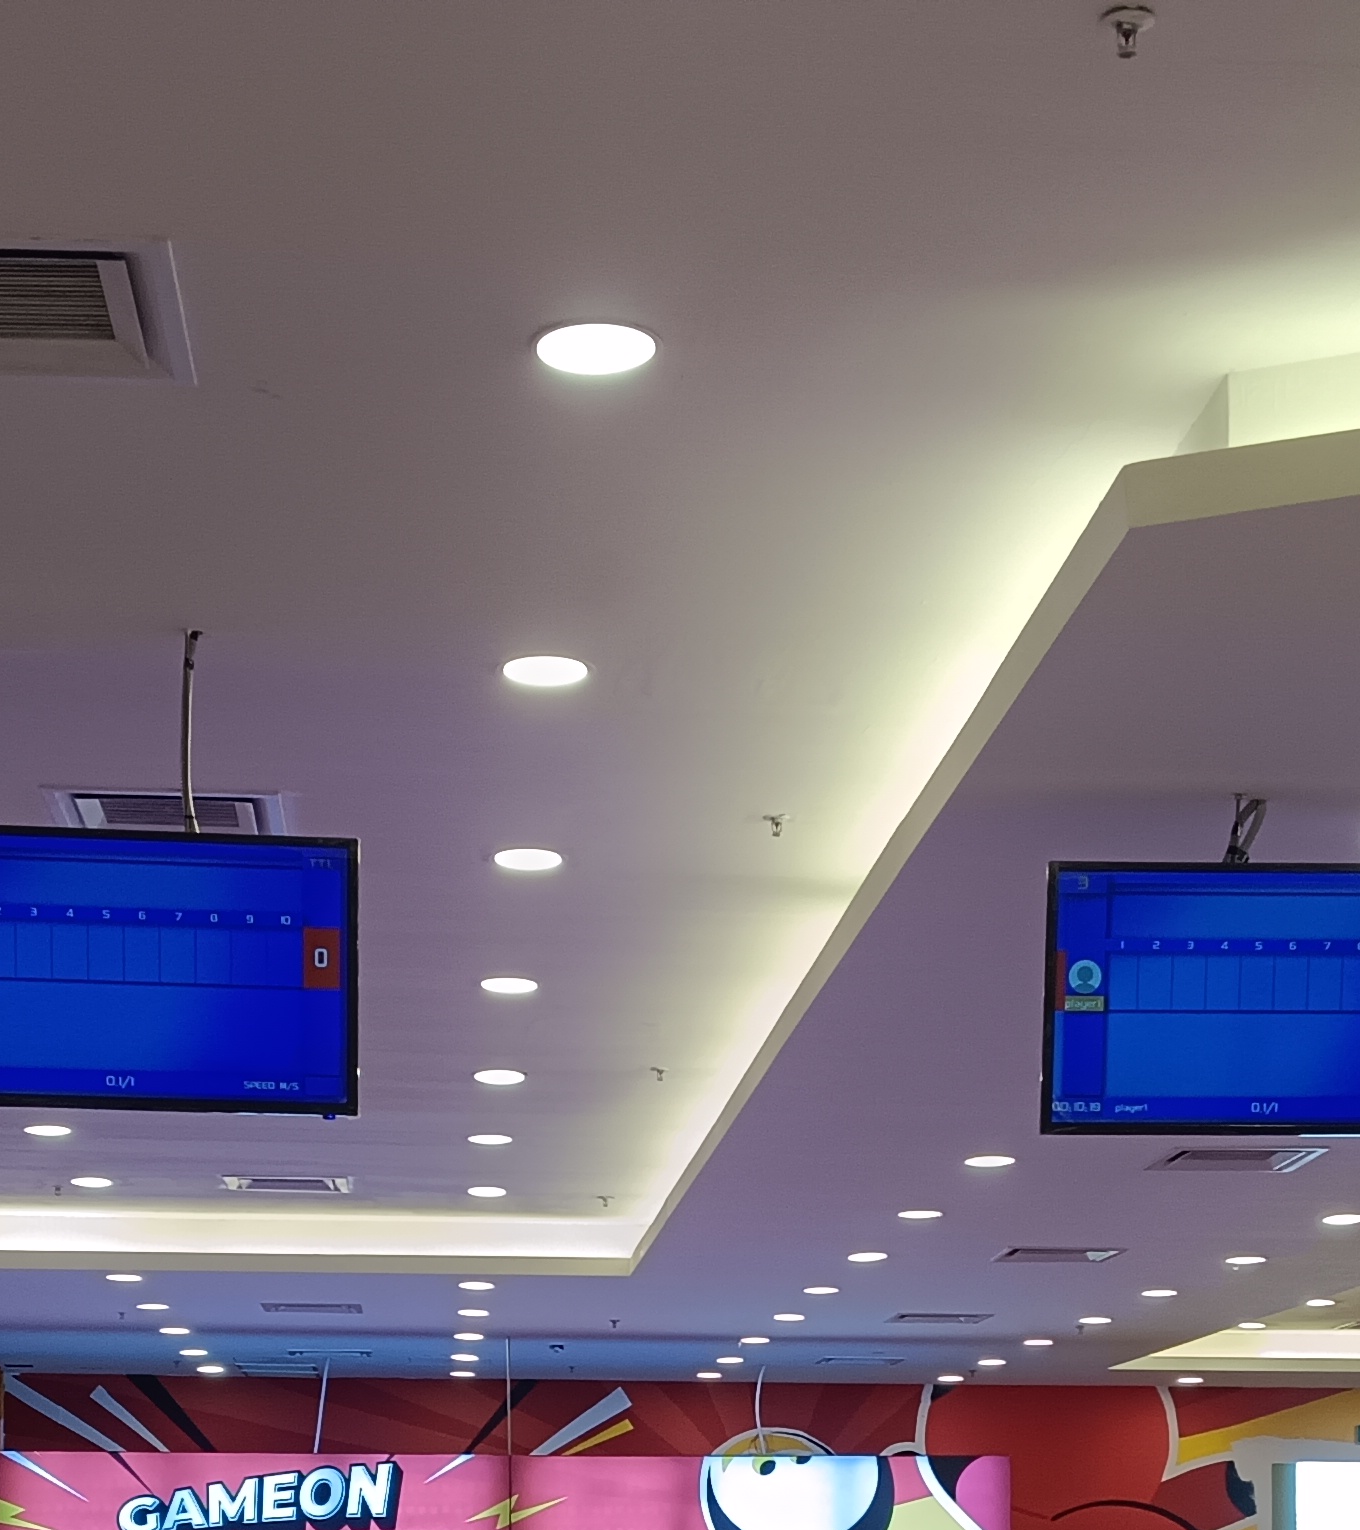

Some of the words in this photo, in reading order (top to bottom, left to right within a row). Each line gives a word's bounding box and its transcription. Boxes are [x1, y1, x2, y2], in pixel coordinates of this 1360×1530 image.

[30, 907, 38, 917] 3
[66, 908, 74, 918] 4
[102, 909, 111, 919] 5
[138, 910, 147, 920] 6
[175, 912, 183, 921] 7
[245, 914, 254, 924] 9
[280, 915, 291, 925] 10
[1152, 940, 1160, 950] 2
[1187, 940, 1195, 950] 3
[1220, 941, 1229, 950] 4
[1255, 941, 1263, 951] 5
[1288, 941, 1297, 951] 6
[1324, 941, 1331, 950] 7
[314, 948, 328, 968] 0
[243, 1080, 276, 1090] SPEED
[279, 1082, 299, 1091] M/S
[1114, 1103, 1148, 1114] player1
